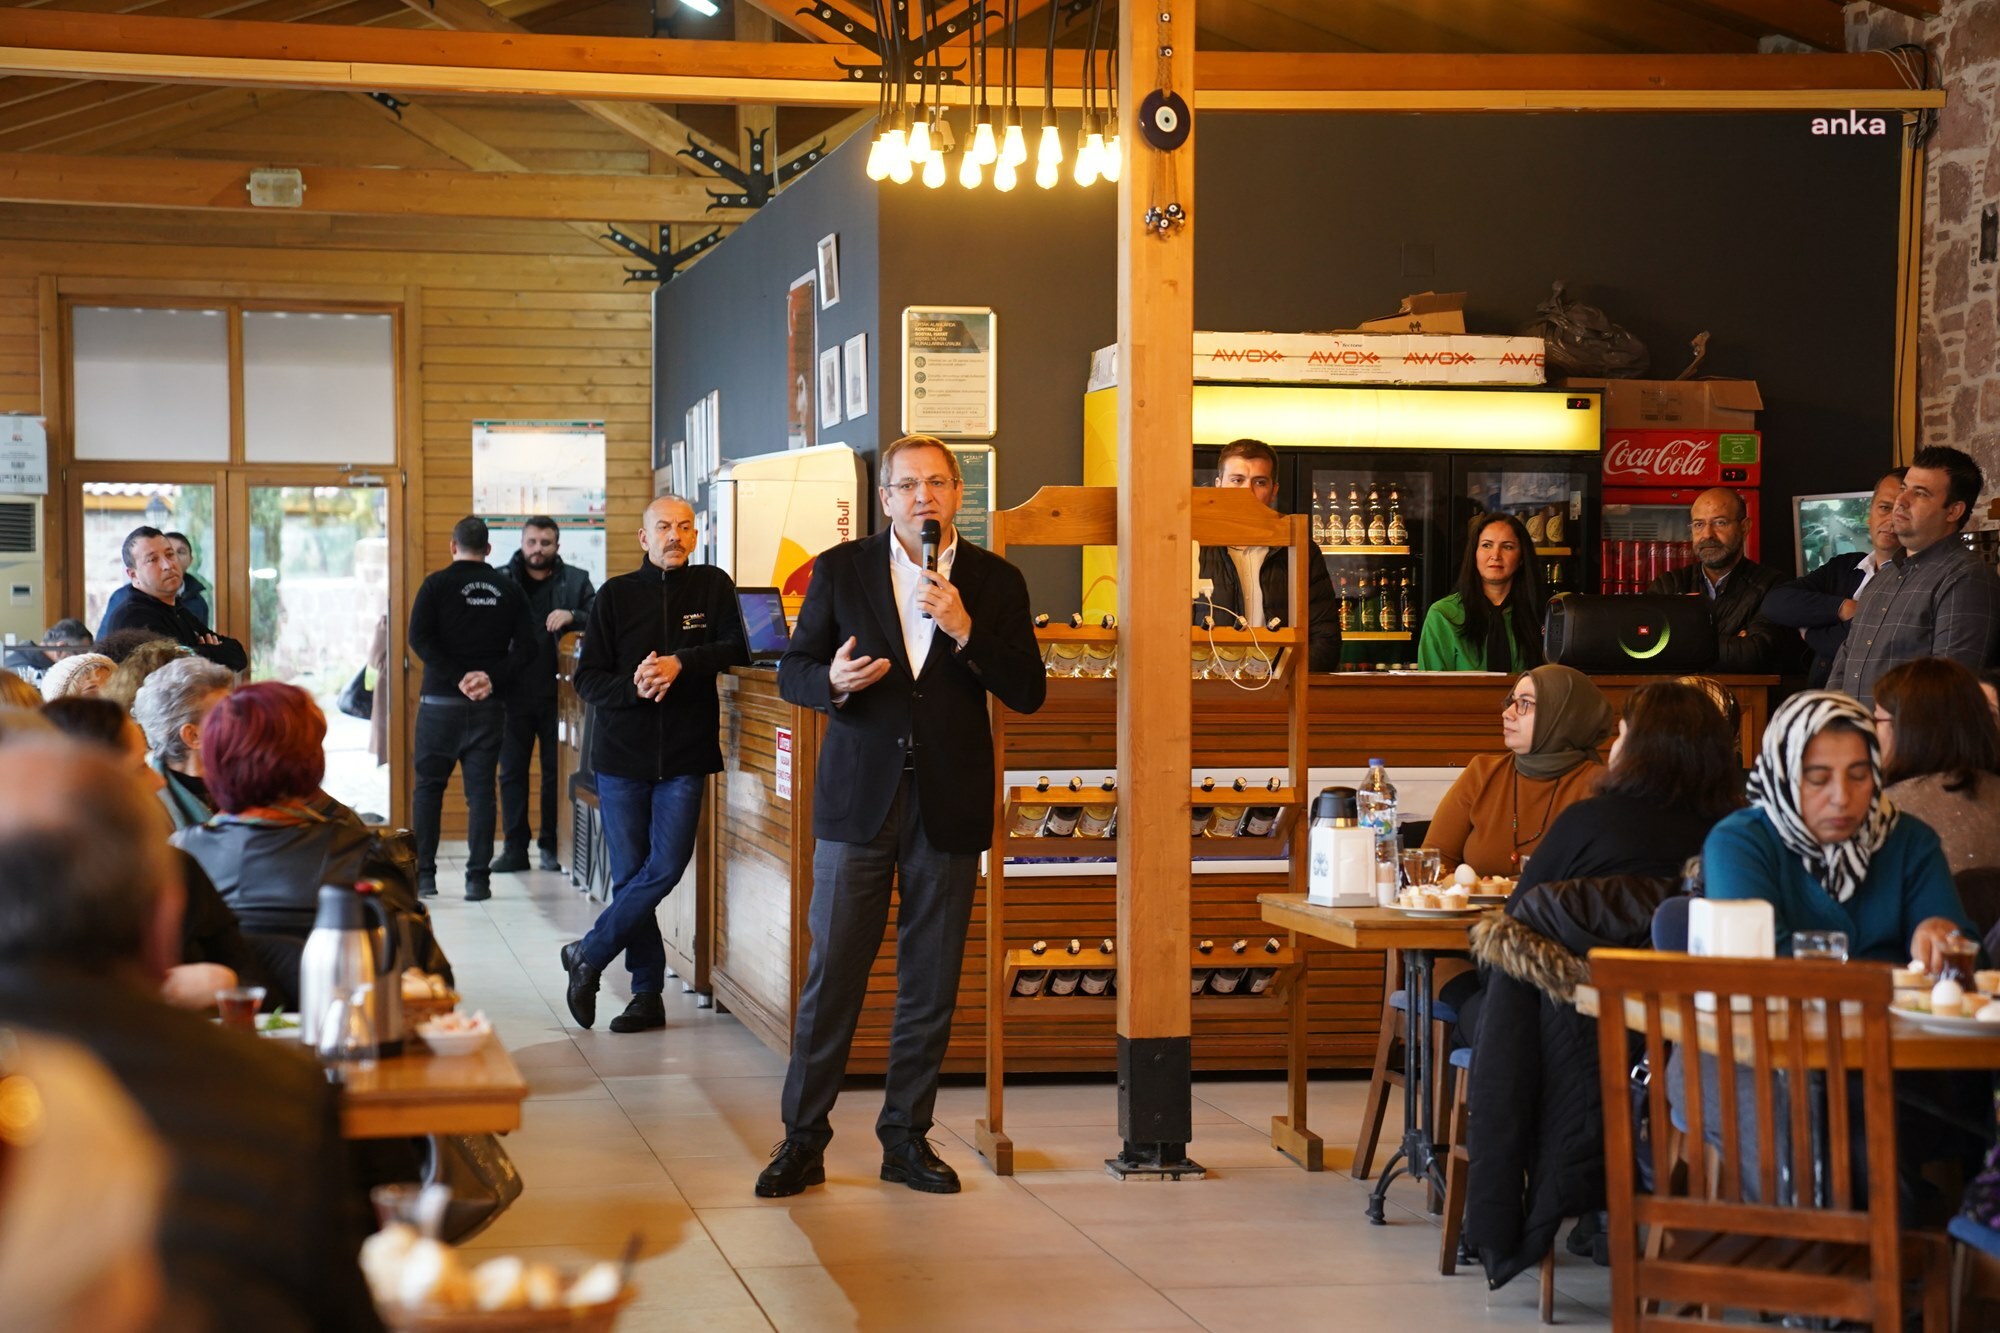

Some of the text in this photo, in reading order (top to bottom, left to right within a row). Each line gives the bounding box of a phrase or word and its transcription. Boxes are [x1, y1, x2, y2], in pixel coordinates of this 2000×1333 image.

[1212, 349, 1279, 363] AWOX
[1308, 351, 1375, 364] AWOX
[1403, 352, 1470, 365] AWOX
[1603, 439, 1712, 476] Coca-Cola
[837, 501, 849, 543] ed Bull
